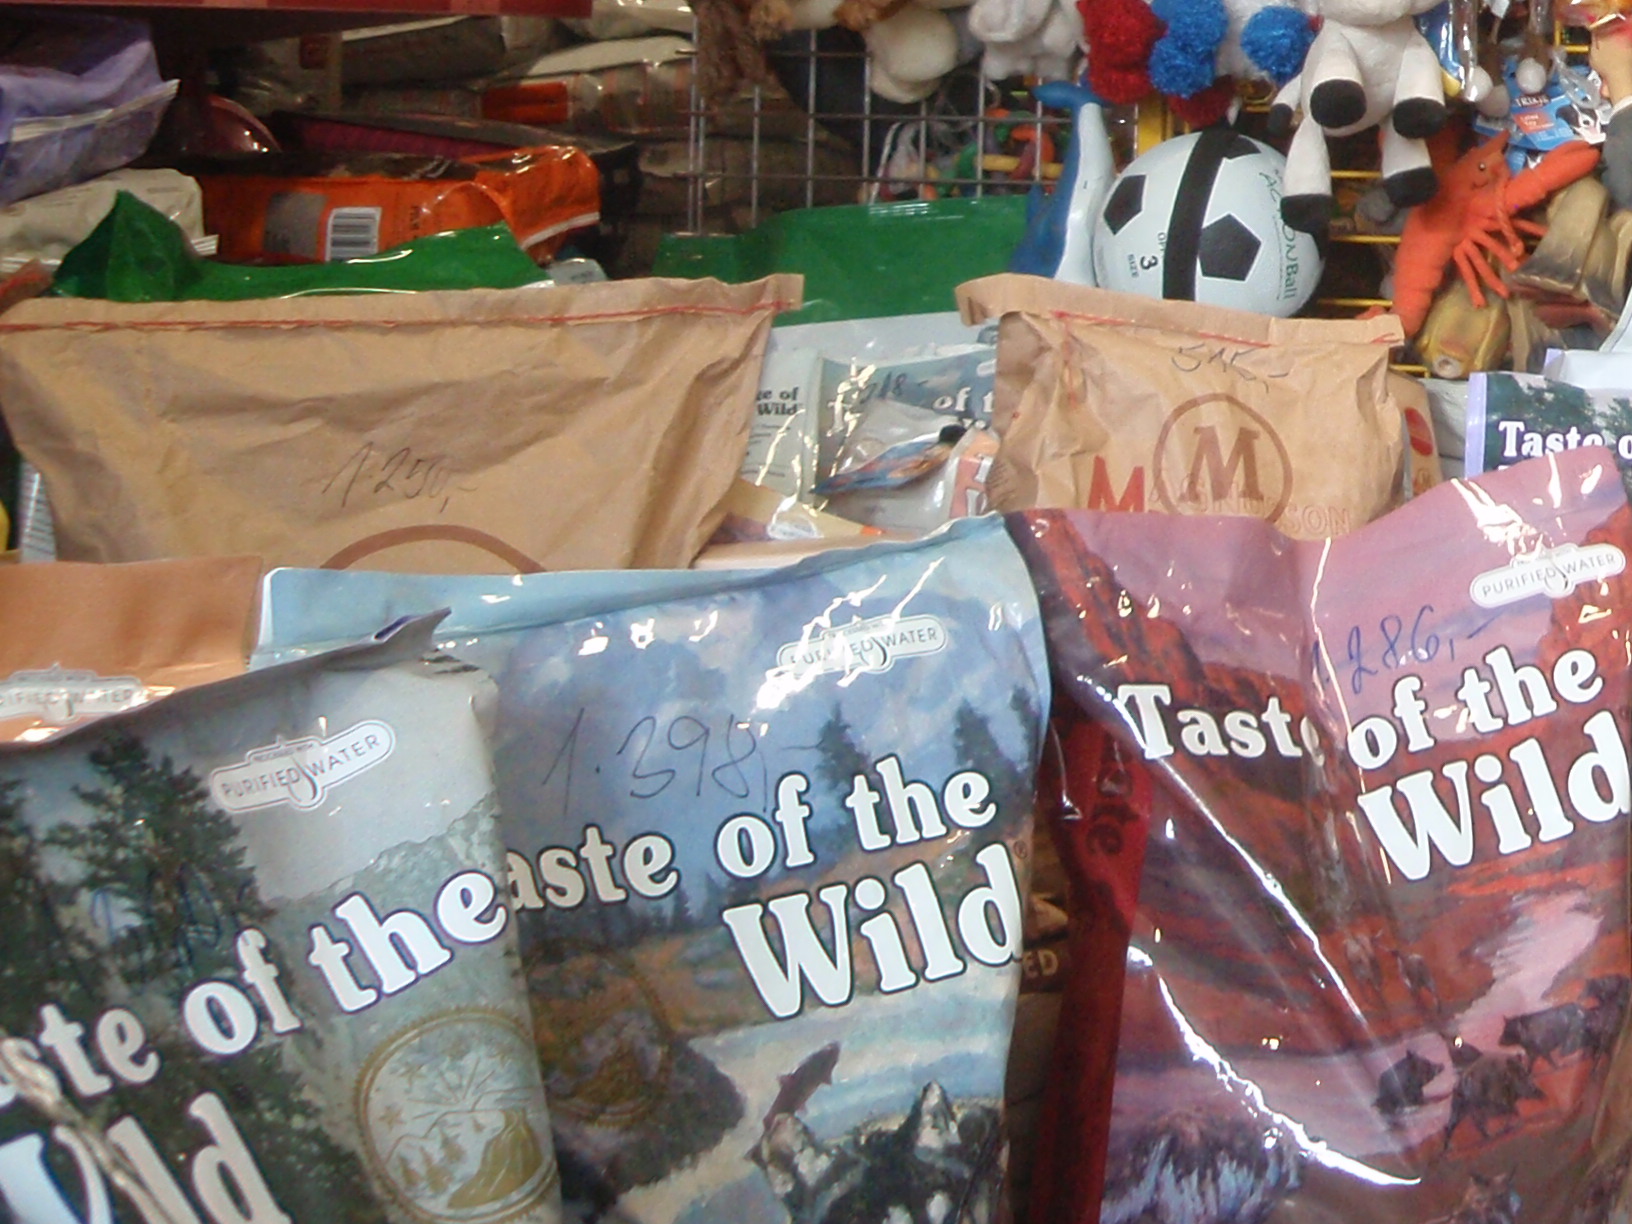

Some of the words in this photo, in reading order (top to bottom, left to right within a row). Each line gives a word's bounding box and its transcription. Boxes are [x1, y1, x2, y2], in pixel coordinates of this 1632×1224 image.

[1139, 255, 1159, 271] 3
[756, 402, 799, 416] Wild
[932, 387, 972, 412] of
[1481, 566, 1558, 598] PURIFIED
[1561, 553, 1618, 577] WATER
[881, 626, 937, 648] WATER
[1347, 676, 1437, 771] of
[1456, 644, 1604, 751] the
[221, 766, 299, 798] PURIFIED
[308, 733, 382, 777] WATER
[1357, 710, 1632, 883] Wild
[506, 825, 682, 912] aste
[715, 771, 816, 878] of
[844, 754, 998, 853] the
[722, 842, 1024, 1020] Wild
[0, 1004, 162, 1108] ste
[182, 927, 302, 1057] of
[308, 870, 508, 1014] the
